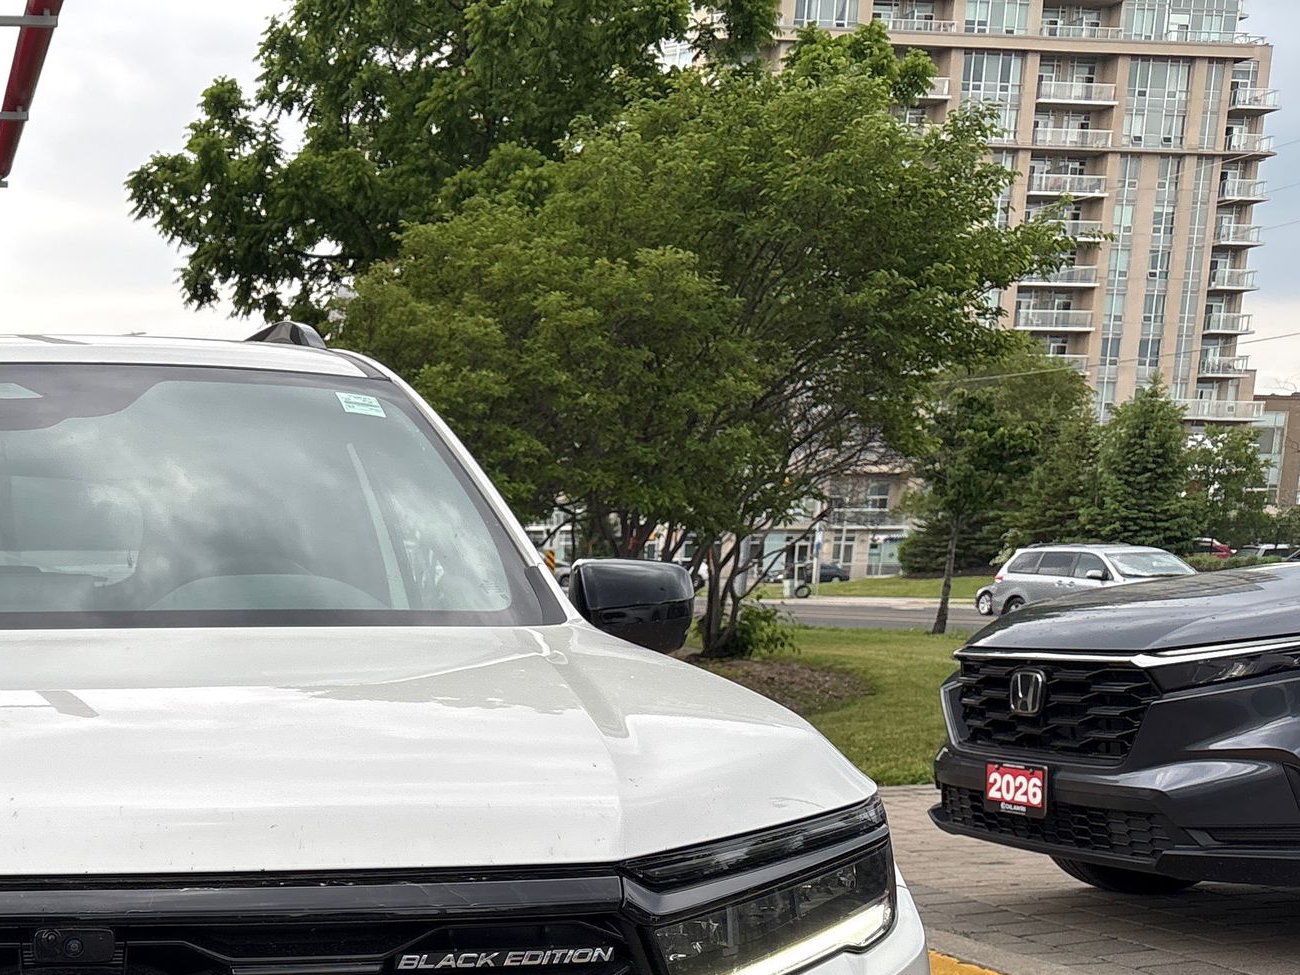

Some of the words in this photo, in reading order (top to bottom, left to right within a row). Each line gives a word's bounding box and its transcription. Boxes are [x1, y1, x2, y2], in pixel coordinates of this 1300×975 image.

[988, 772, 1043, 805] 2026
[397, 952, 500, 970] BLACK
[503, 947, 614, 966] EDITION
